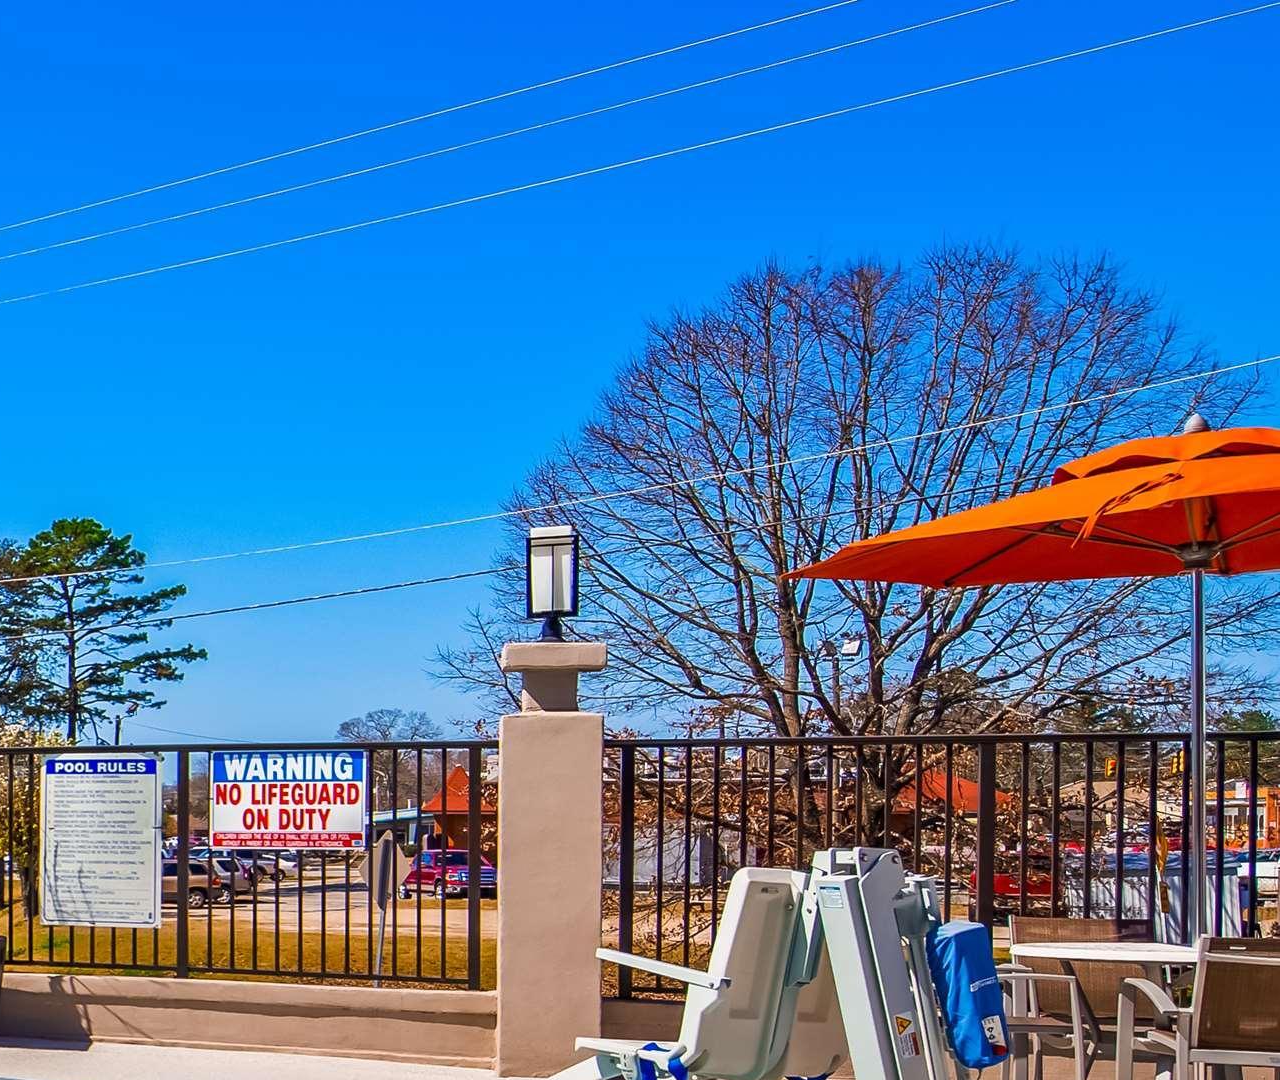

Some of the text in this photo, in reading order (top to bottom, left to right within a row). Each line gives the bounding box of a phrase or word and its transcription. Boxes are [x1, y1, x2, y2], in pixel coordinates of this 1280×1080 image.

[55, 762, 147, 773] POOL RULES
[224, 753, 353, 781] WARNING
[216, 783, 360, 806] NO LIFEGUARD
[242, 808, 331, 830] ON DUTY
